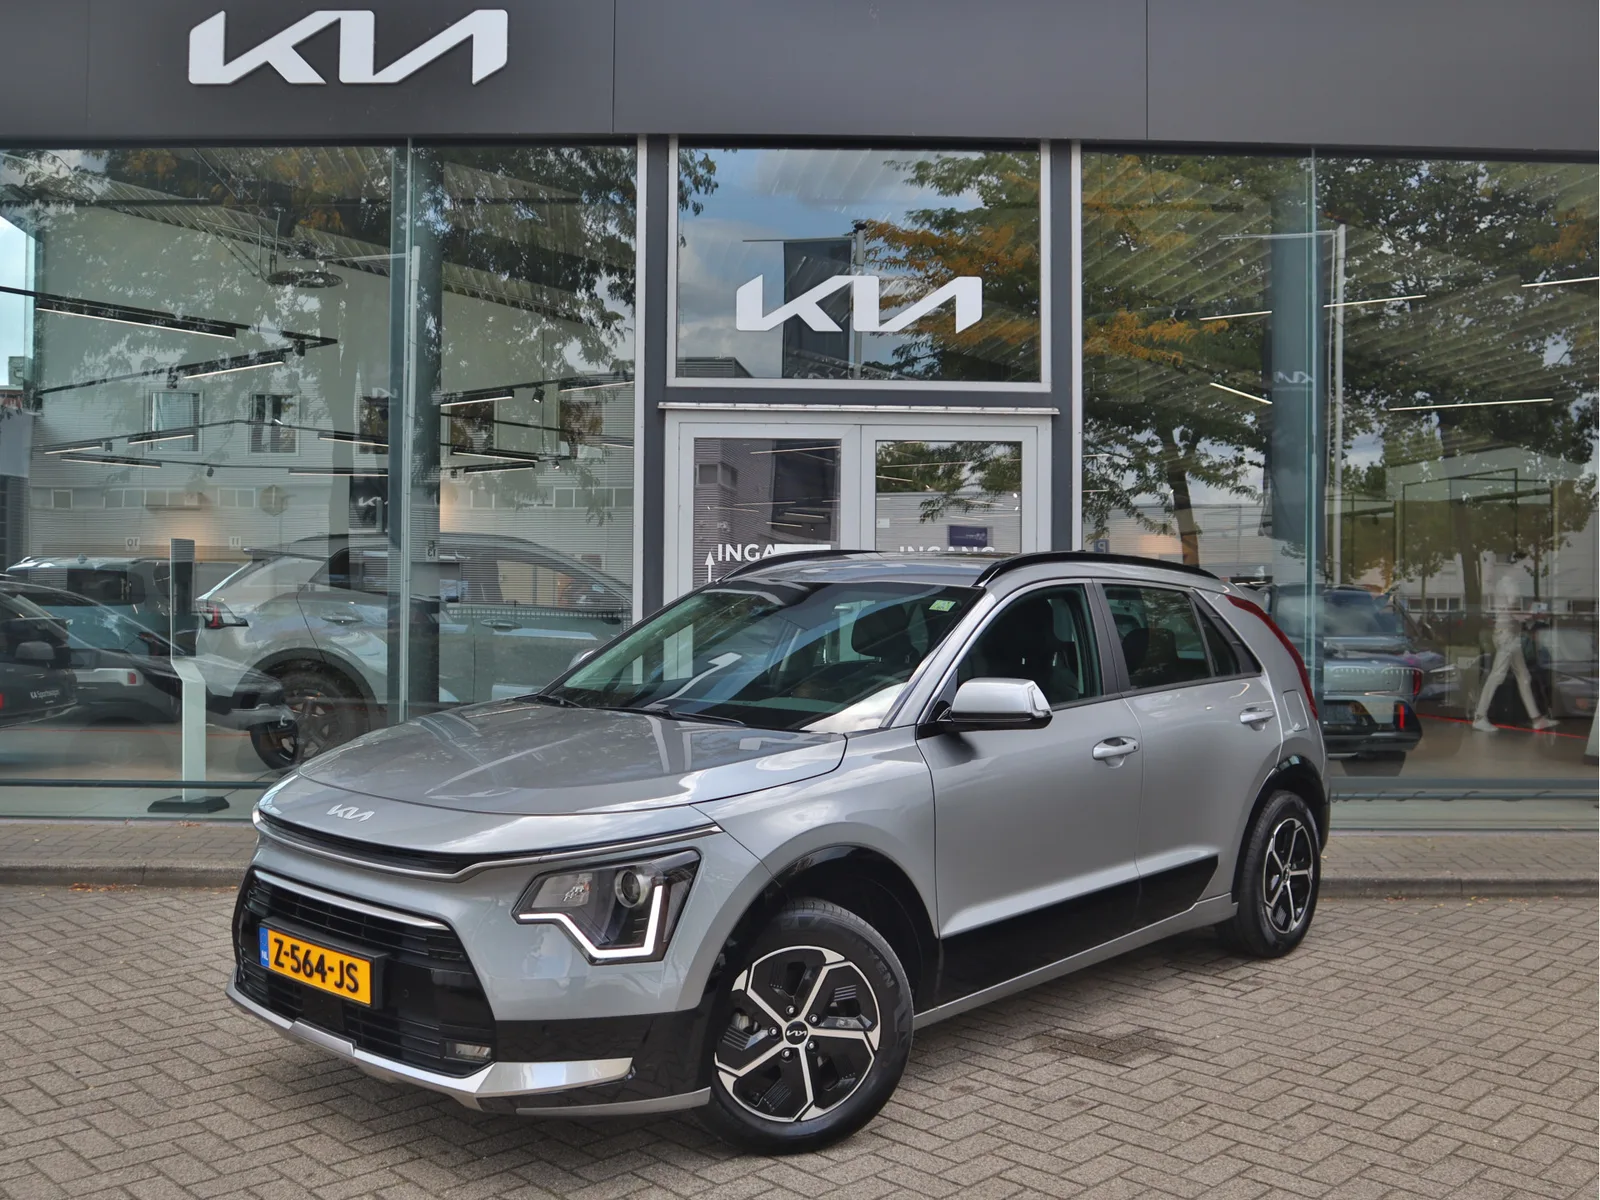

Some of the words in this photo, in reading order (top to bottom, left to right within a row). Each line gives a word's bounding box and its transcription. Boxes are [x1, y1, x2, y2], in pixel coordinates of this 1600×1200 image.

[188, 9, 508, 84] KIA
[735, 274, 983, 334] KIA
[717, 543, 777, 562] INGA
[326, 803, 374, 823] KIA
[273, 937, 359, 993] Z-564-JS
